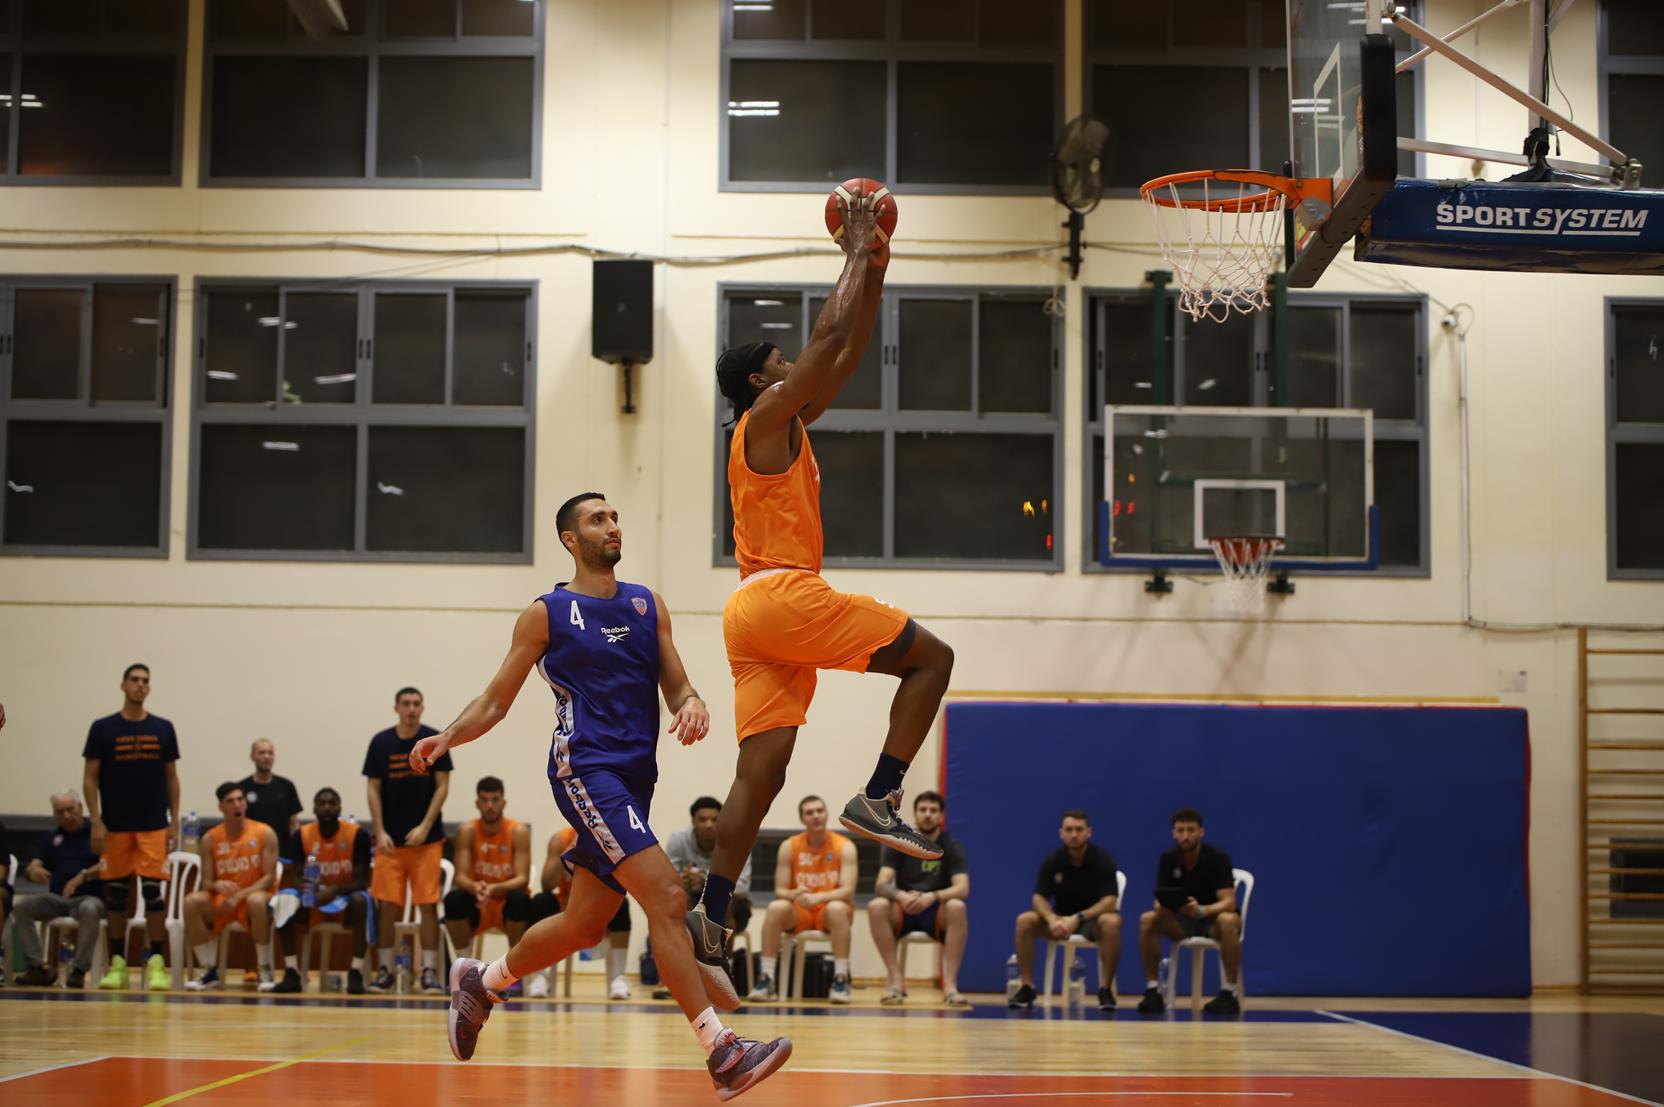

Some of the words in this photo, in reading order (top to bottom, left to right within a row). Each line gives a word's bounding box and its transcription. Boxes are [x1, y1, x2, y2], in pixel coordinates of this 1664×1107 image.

[1436, 203, 1530, 227] SPORT
[1533, 208, 1649, 233] SYSTEM
[570, 600, 585, 630] 4
[600, 625, 630, 634] Reebok
[627, 805, 646, 833] 4
